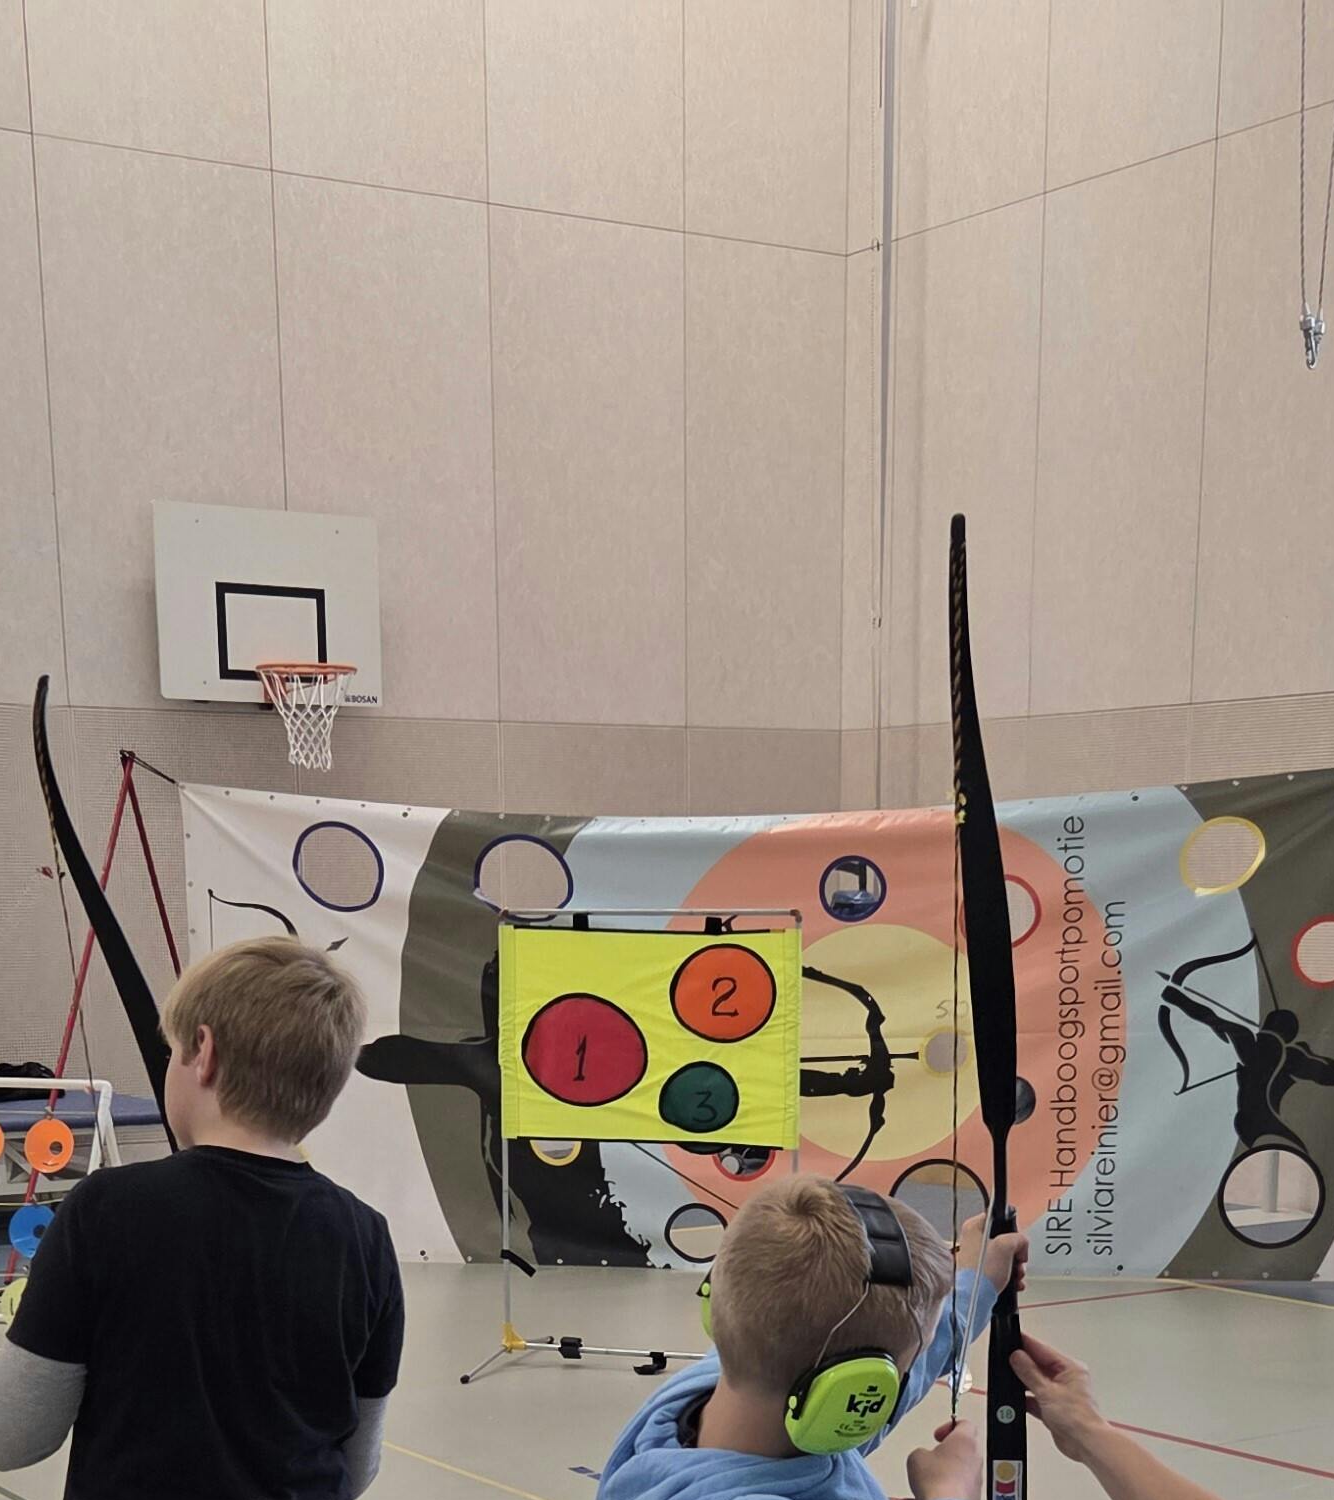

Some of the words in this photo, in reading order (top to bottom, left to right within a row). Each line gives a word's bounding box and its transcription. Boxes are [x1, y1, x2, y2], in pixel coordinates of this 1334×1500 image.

[351, 694, 378, 704] BOSAN
[711, 976, 740, 1018] 2
[1049, 815, 1086, 1188] Handboogsportpomotie
[573, 1033, 588, 1082] 1
[1086, 900, 1127, 1256] silviareinier@gmail.com
[692, 1090, 718, 1125] 3
[1045, 1198, 1073, 1256] SIRE
[845, 1393, 887, 1418] kid
